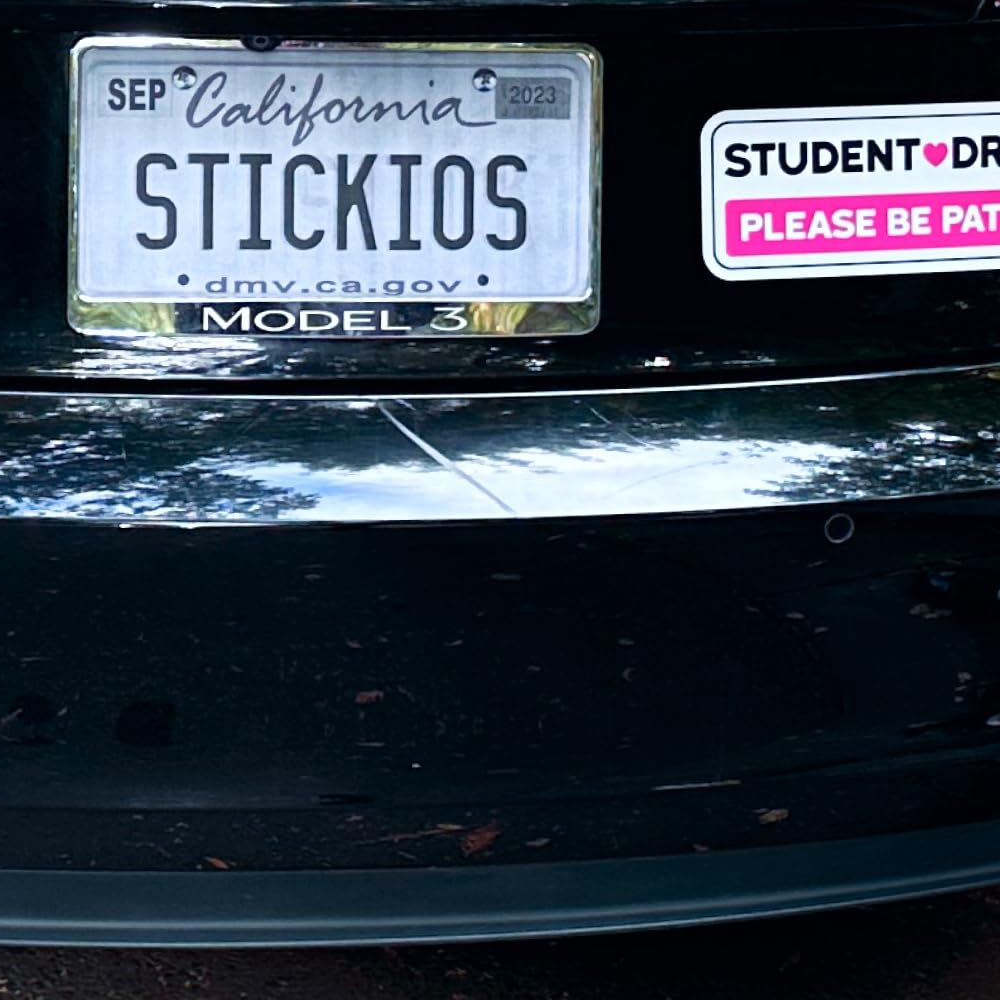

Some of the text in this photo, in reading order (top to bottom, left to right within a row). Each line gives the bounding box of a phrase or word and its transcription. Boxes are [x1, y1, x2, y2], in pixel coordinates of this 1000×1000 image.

[107, 78, 166, 111] SEP
[186, 70, 497, 147] California
[509, 85, 557, 105] 2023
[724, 136, 921, 178] STUDENT
[135, 152, 528, 251] STICKIOS
[740, 208, 877, 242] PLEASE
[887, 206, 932, 237] BE
[204, 276, 462, 294] dmv.ca.gov
[201, 305, 468, 332] MODEL 3
